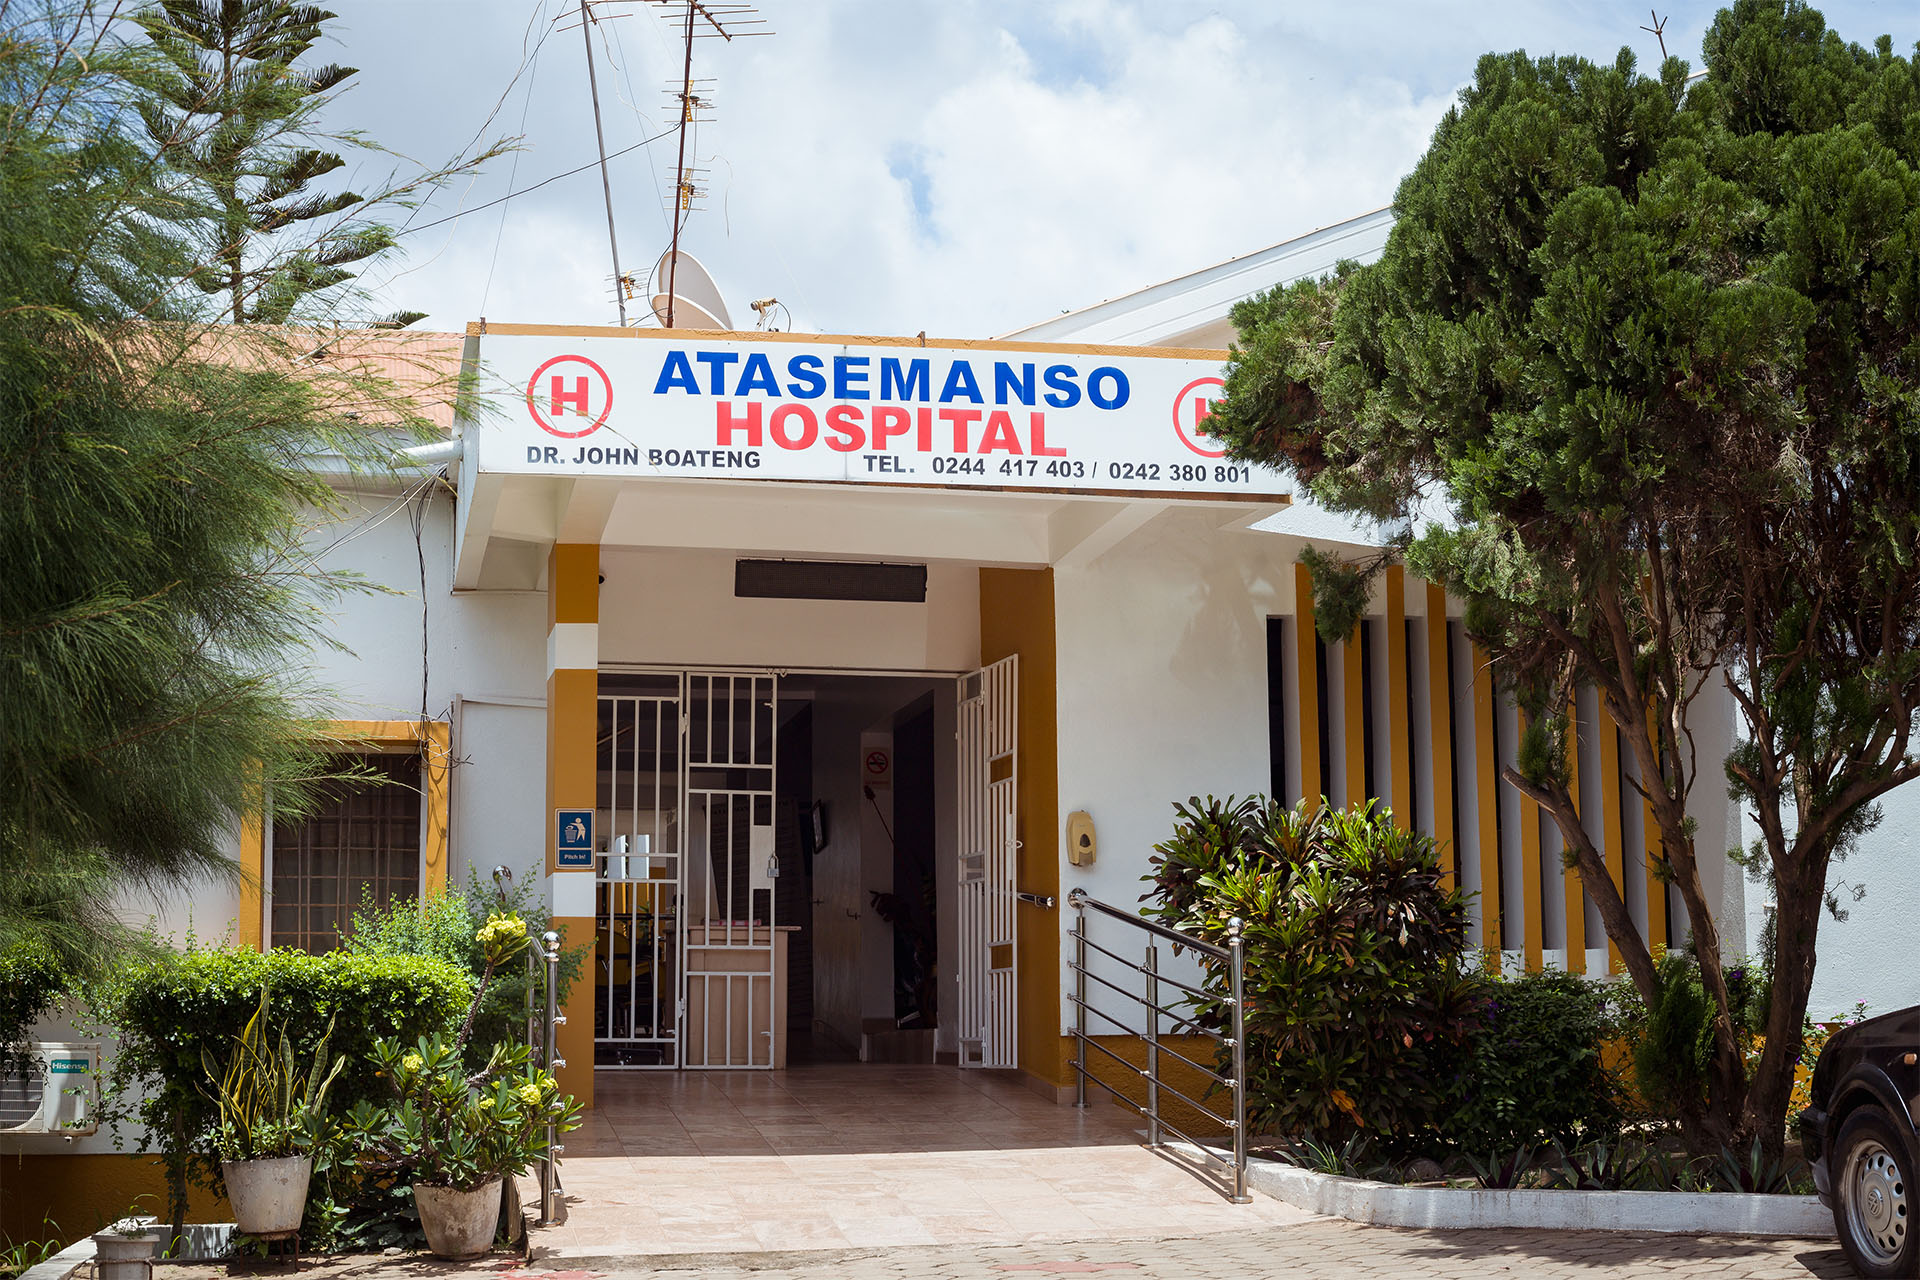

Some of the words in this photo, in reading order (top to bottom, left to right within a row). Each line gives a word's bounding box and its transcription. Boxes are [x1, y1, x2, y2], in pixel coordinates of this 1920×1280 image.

[551, 376, 588, 416] H
[653, 351, 1130, 410] ATASEMANSO
[717, 401, 1066, 456] HOSPITAL
[528, 446, 566, 463] DR.
[573, 447, 638, 464] JOHN
[649, 450, 761, 468] BOATENG
[864, 455, 914, 472] TEL.
[932, 457, 986, 475] 0244
[1000, 460, 1037, 476] 417
[1047, 461, 1084, 477] 403
[1110, 463, 1159, 480] 0242
[1170, 465, 1206, 481] 380
[1215, 462, 1248, 482] 801
